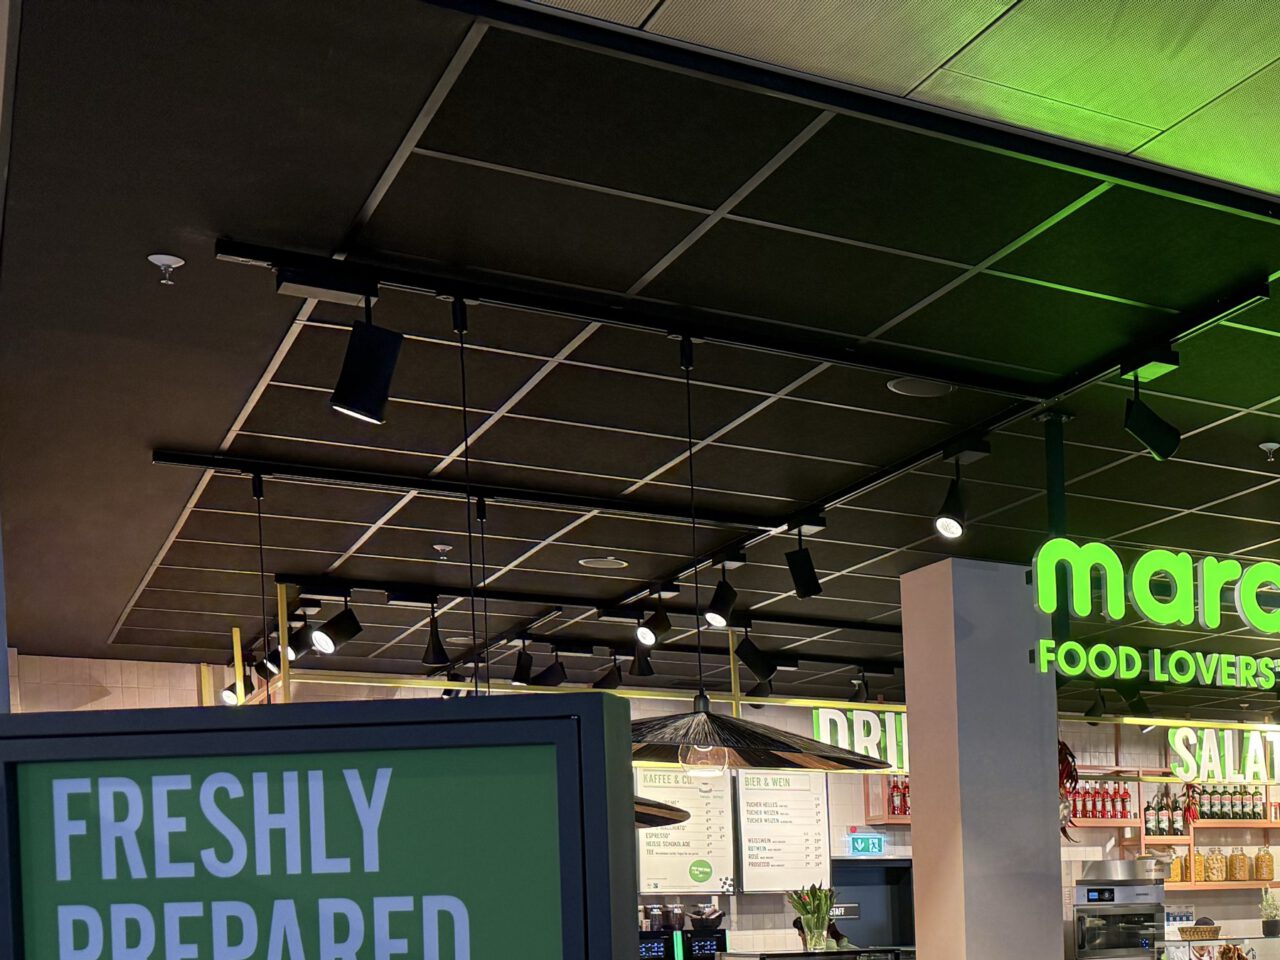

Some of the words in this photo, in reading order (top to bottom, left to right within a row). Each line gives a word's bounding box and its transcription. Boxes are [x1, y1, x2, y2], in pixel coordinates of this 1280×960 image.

[1039, 639, 1142, 680] FOOD
[643, 774, 672, 784] KAFFEE
[674, 775, 680, 785] &
[744, 777, 761, 787] BIER
[763, 777, 769, 787] &
[772, 777, 791, 787] WEIN
[51, 767, 393, 882] FRESHLY
[829, 907, 845, 916] STAFF
